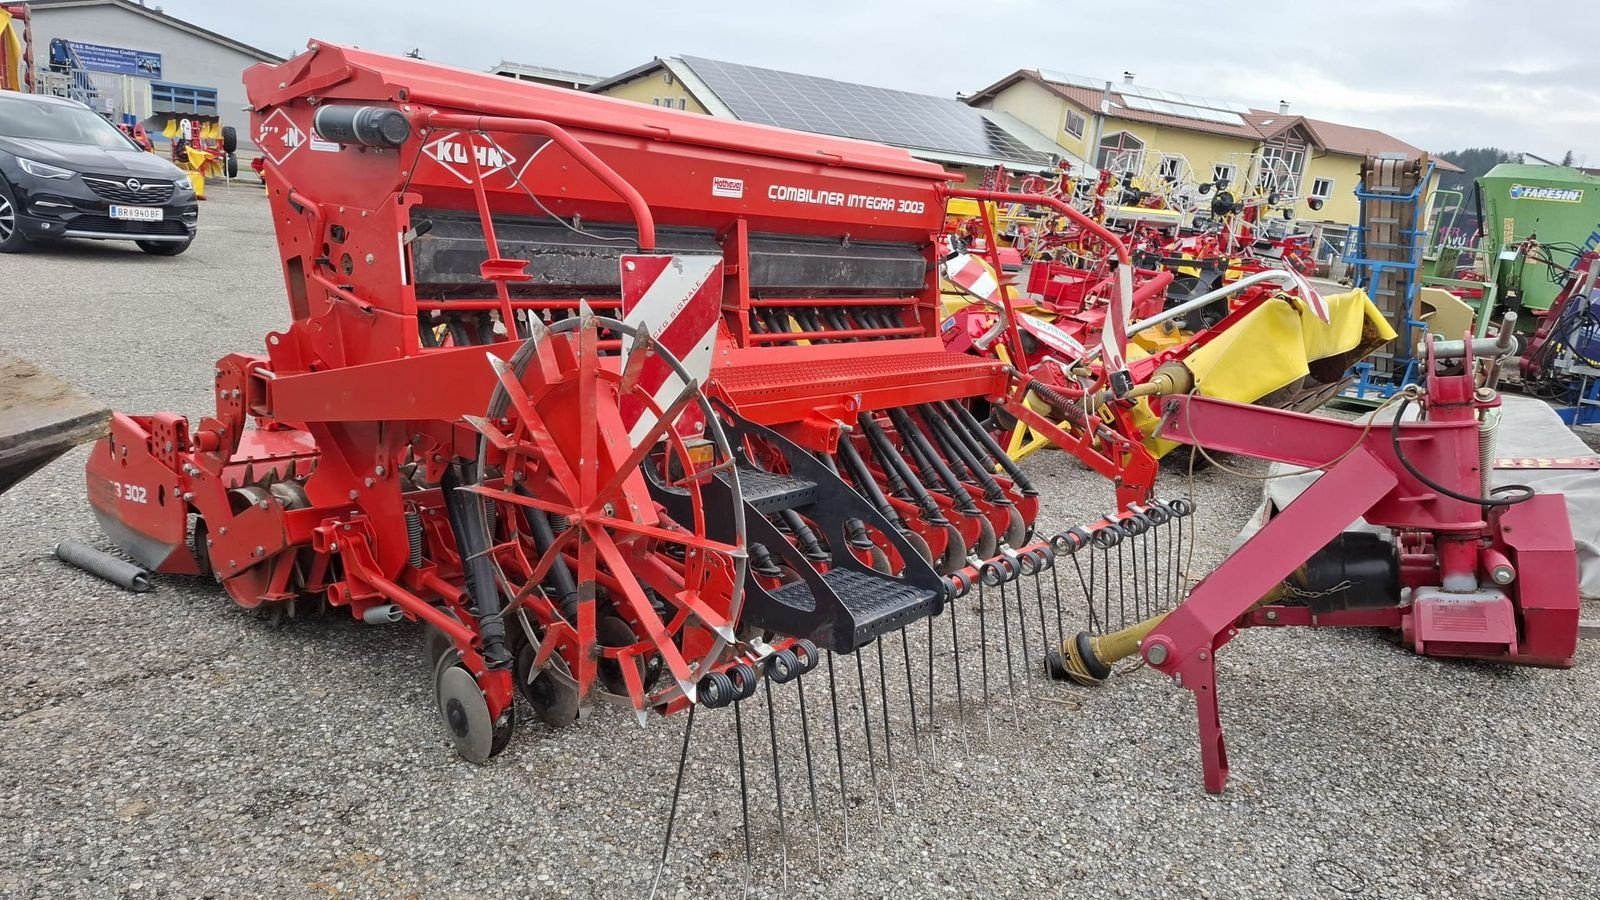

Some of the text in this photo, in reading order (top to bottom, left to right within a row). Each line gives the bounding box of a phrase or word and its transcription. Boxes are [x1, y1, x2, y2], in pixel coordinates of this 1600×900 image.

[437, 141, 503, 168] KUHN
[768, 185, 925, 214] COMBILINER INTEGRA 3003
[1523, 188, 1579, 201] FARESIN
[118, 207, 129, 217] BR
[670, 280, 702, 319] SIGNALE
[124, 483, 147, 504] 302
